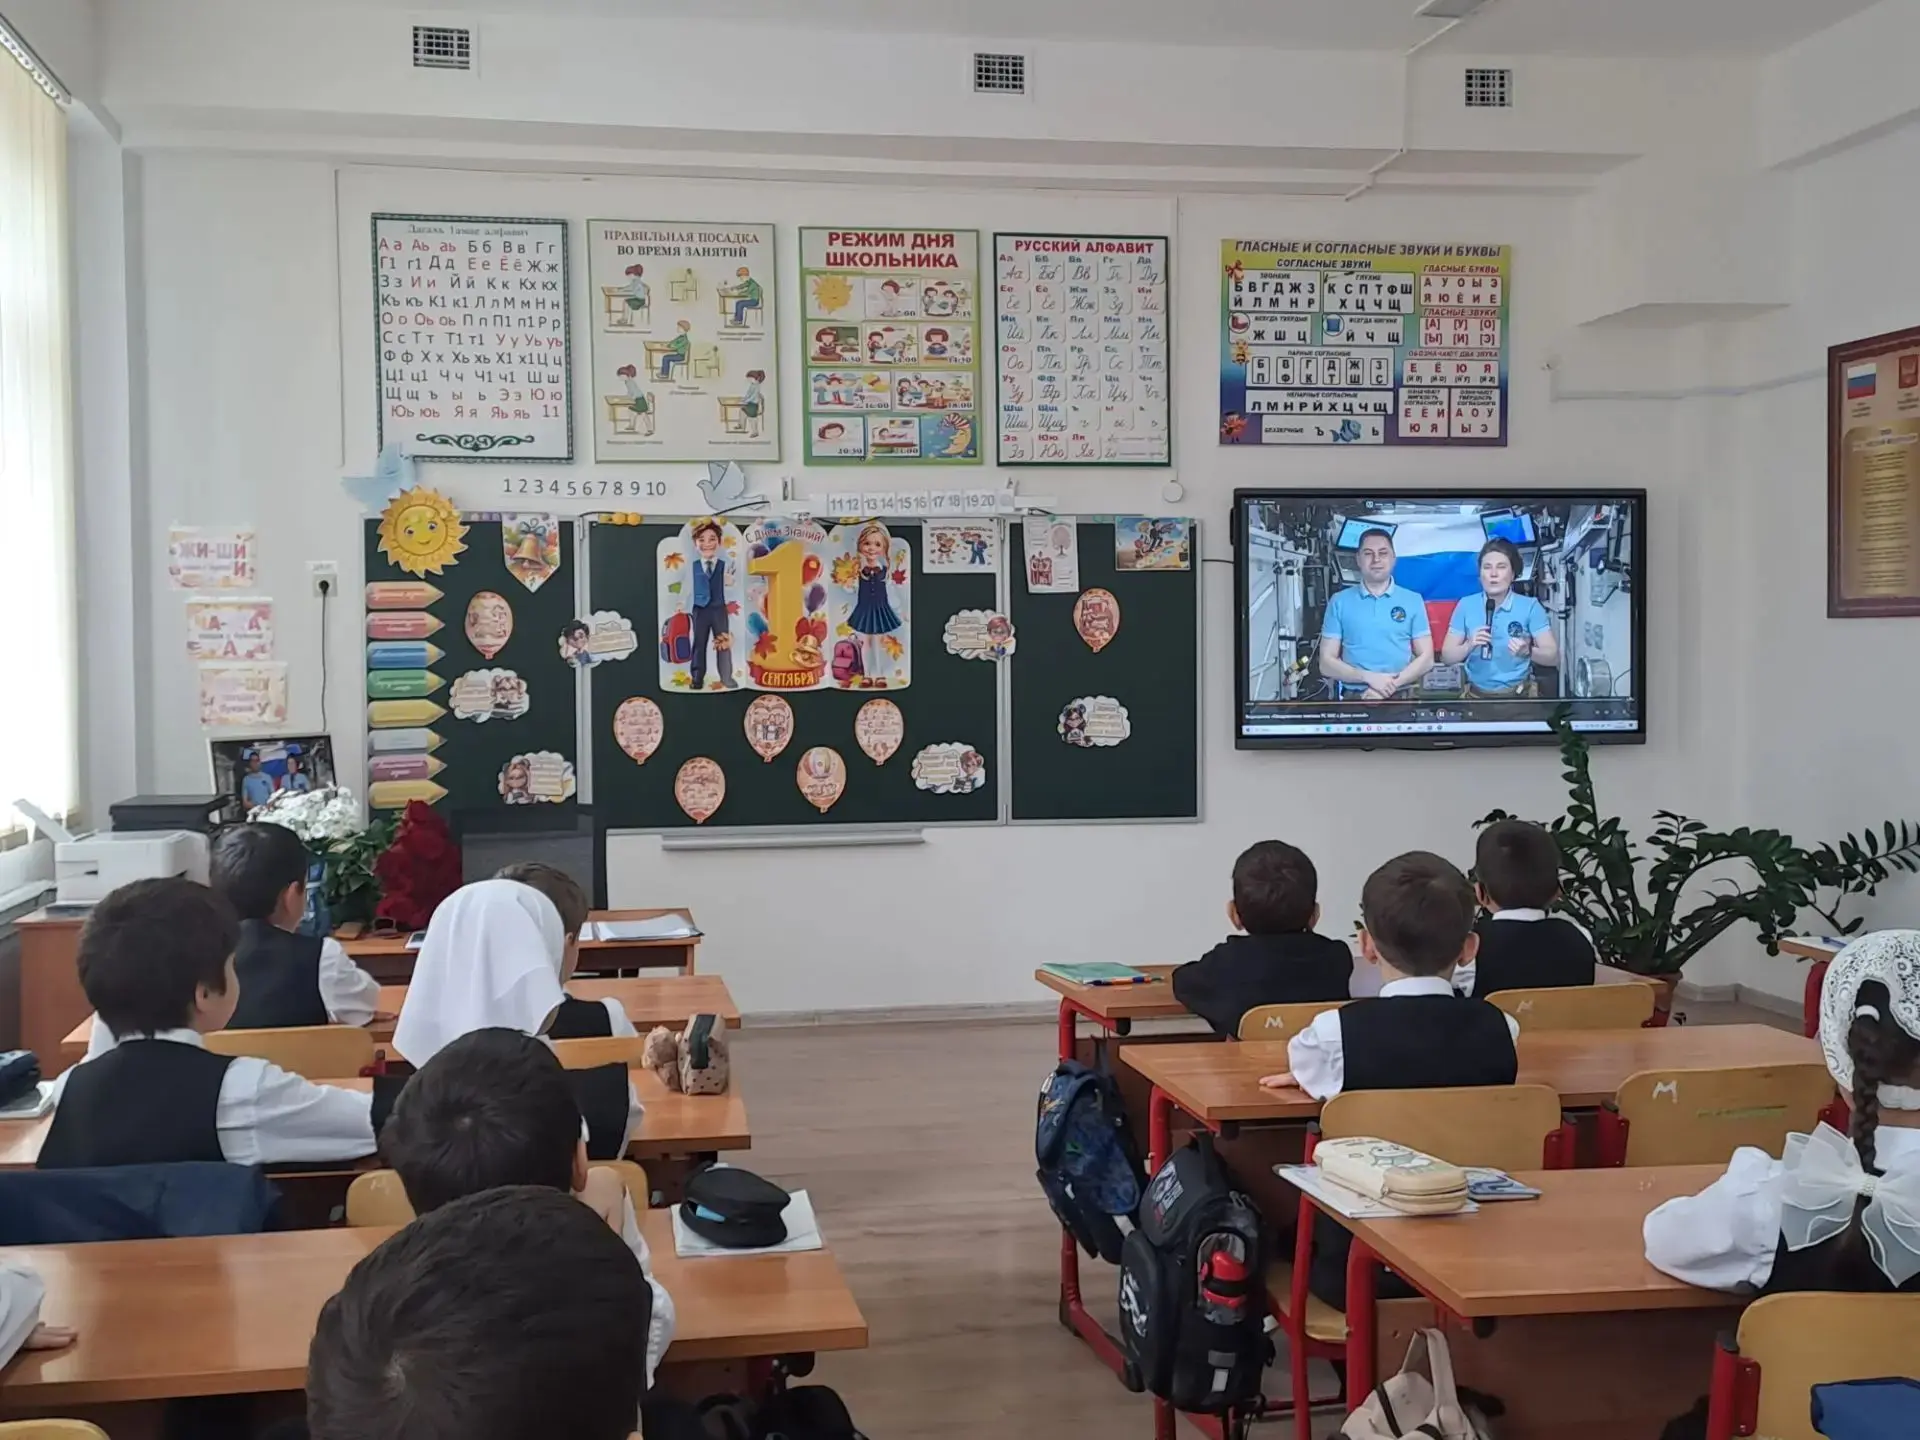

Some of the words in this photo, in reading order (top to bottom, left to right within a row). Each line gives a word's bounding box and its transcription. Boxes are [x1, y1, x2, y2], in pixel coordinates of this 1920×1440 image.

[604, 230, 694, 243] ПРАВИЛЬНАЯ
[698, 232, 760, 244] ПОСАДКА
[828, 232, 905, 248] РЕЖИМ
[911, 234, 954, 250] ДНЯ
[617, 246, 635, 255] ВО
[638, 247, 681, 256] ВРЕМЯ
[685, 246, 747, 257] ЗАНЯТИЙ
[1015, 239, 1080, 252] РУССКИЙ
[1086, 242, 1154, 254] АЛФАВИТ
[1235, 241, 1301, 253] ГЛАСНЫЕ
[1304, 243, 1313, 252] И
[1317, 242, 1396, 255] СОГЛАСНЫЕ
[1400, 245, 1440, 256] ЗВУКИ
[1443, 247, 1453, 256] И
[1456, 246, 1501, 257] БУКВЫ
[826, 252, 958, 268] ШКОЛЬНИКА
[1277, 259, 1337, 268] СОГЛАСНЫЕ
[1340, 260, 1371, 269] ЗВУКИ
[1423, 265, 1466, 273] ГЛАСНЫЕ
[1469, 265, 1499, 273] БУКВЫ
[1235, 282, 1243, 293] Б
[1249, 282, 1257, 293] В
[1262, 282, 1270, 293] Г
[1273, 282, 1284, 295] Д
[1289, 282, 1301, 293] Ж
[1307, 282, 1315, 293] З
[1327, 283, 1336, 294] К
[1345, 283, 1353, 295] С
[1359, 283, 1368, 295] П
[1375, 284, 1383, 295] Т
[1387, 284, 1398, 295] Ф
[1401, 284, 1413, 295] Ш
[1234, 295, 1243, 307] Й
[1252, 297, 1262, 307] Л
[1270, 297, 1280, 308] М
[1290, 297, 1298, 308] Н
[1308, 297, 1315, 308] Р
[1339, 298, 1348, 309] Х
[1356, 298, 1365, 311] Ц
[1374, 298, 1382, 309] Ч
[1388, 299, 1401, 312] Щ
[1423, 308, 1466, 317] ГЛАСНЫЕ
[1469, 309, 1497, 317] ЗВУКИ
[503, 478, 512, 493] 1
[518, 478, 528, 493] 2
[534, 479, 544, 494] 3
[549, 480, 559, 494] 4
[567, 481, 576, 496] 5
[582, 481, 592, 496] 6
[598, 482, 608, 496] 7
[613, 481, 623, 496] 8
[630, 481, 640, 496] 9
[646, 482, 666, 496] 10
[831, 500, 843, 511] 11
[845, 499, 859, 510] 12
[865, 499, 878, 510] 13
[881, 499, 894, 509] 14
[900, 498, 911, 509] 15
[915, 498, 927, 509] 16
[932, 496, 945, 508] 17
[949, 496, 960, 507] 18
[966, 496, 978, 507] 19
[980, 495, 995, 507] 20
[747, 541, 804, 670] 1
[762, 671, 814, 685] СЕНТЯБРЯ
